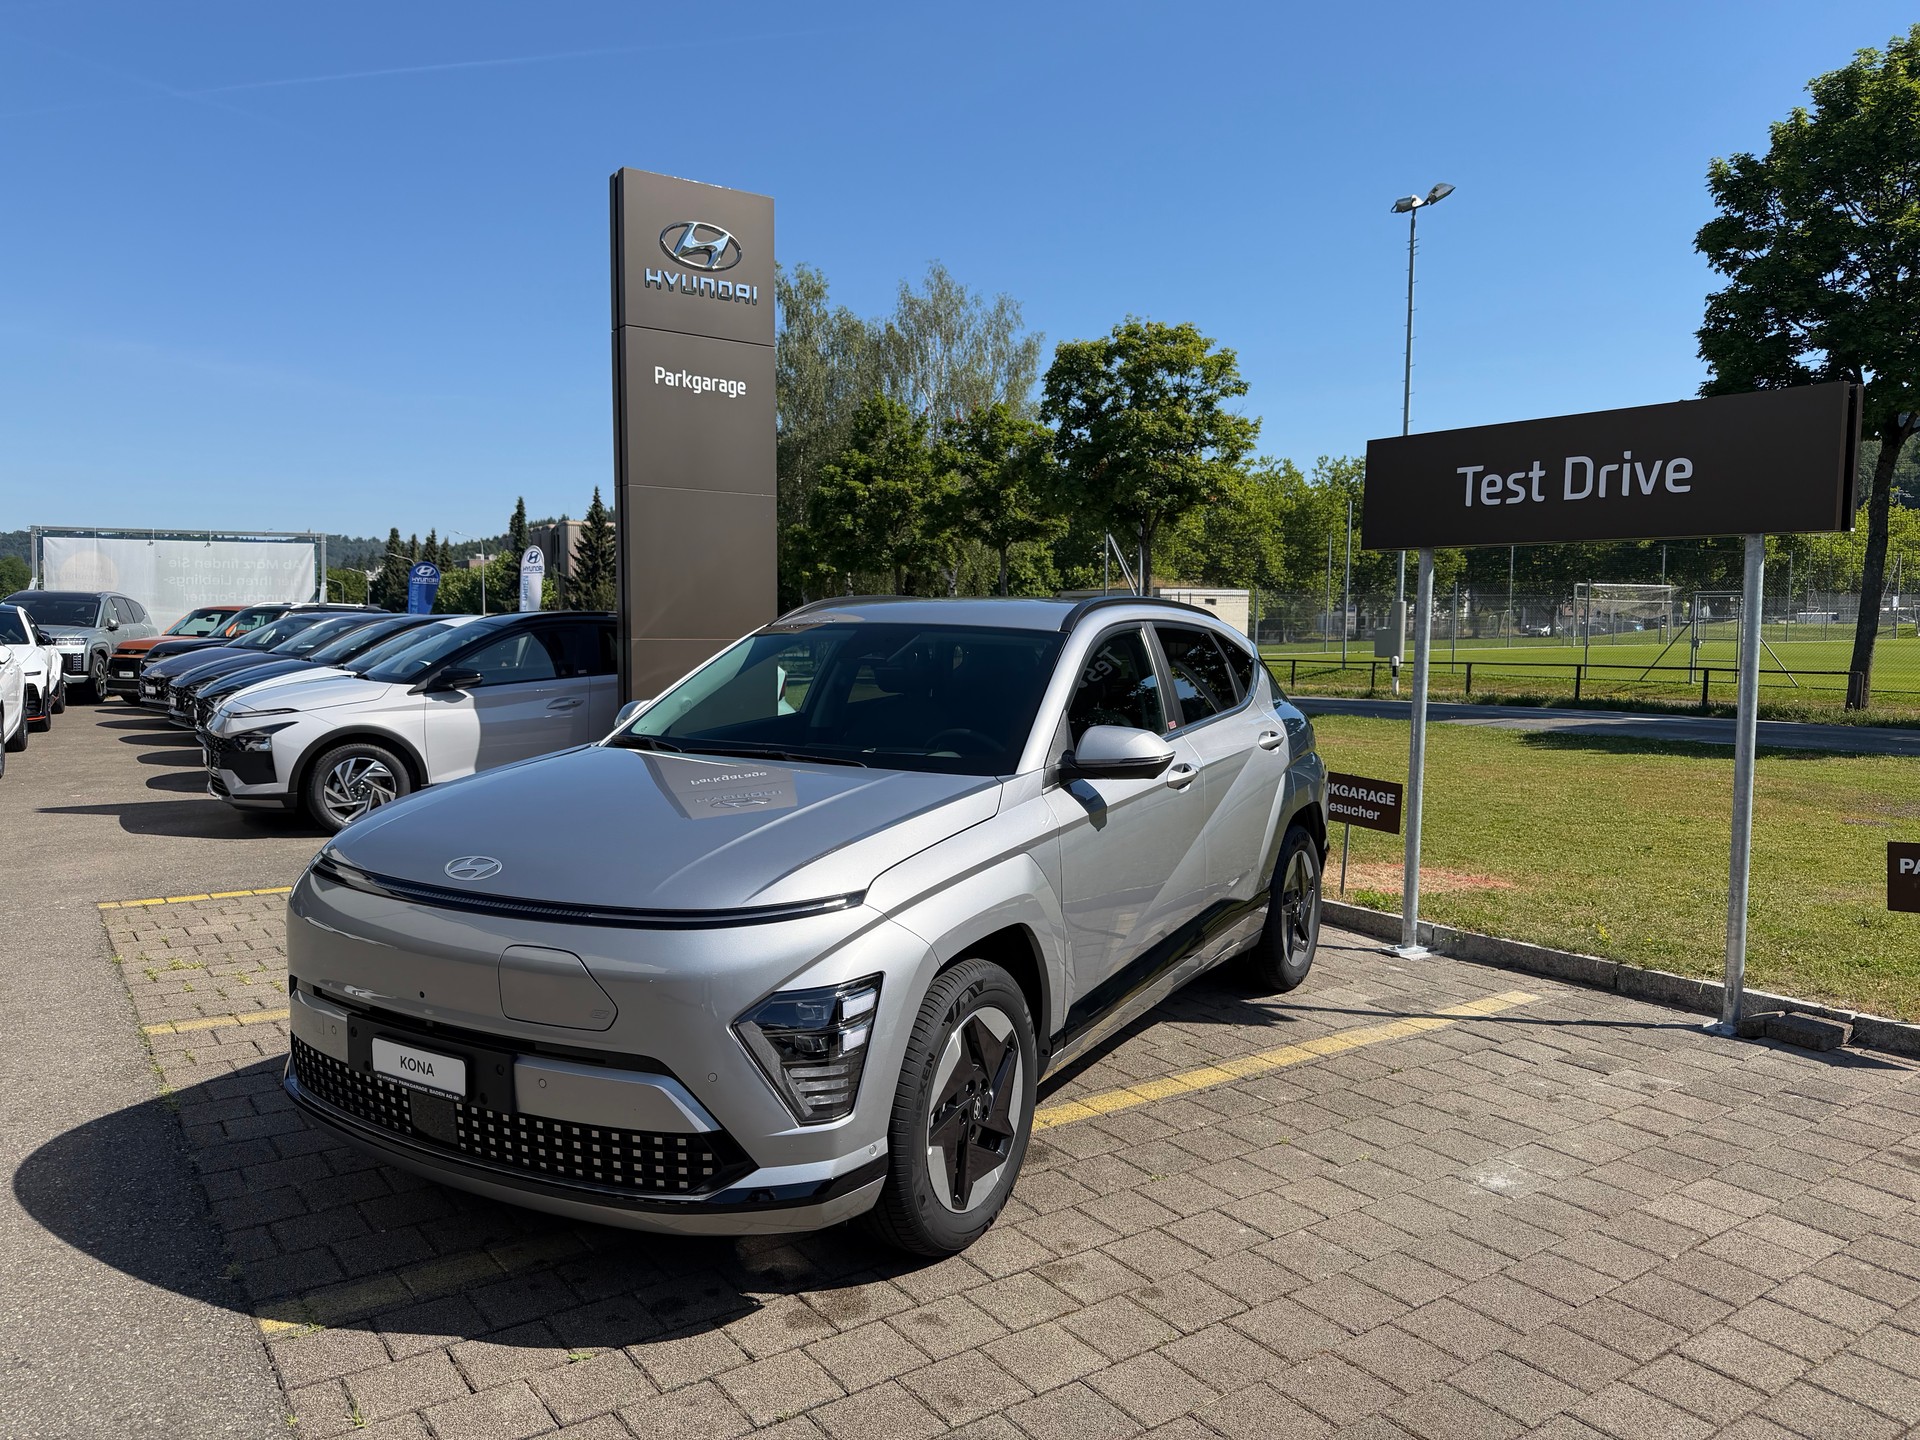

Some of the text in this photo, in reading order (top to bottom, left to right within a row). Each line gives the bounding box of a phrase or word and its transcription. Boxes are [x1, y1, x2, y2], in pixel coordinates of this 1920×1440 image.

[645, 268, 758, 306] HYUNDAI
[654, 365, 747, 399] Parkgarage
[1456, 450, 1694, 507] Test Drive
[522, 565, 543, 573] HYUNDAI
[1329, 802, 1380, 820] esucher
[400, 1055, 434, 1077] KONA
[398, 1079, 428, 1093] PARKGARAGE
[429, 1088, 446, 1098] BADEN
[914, 1052, 935, 1127] NEXEN
